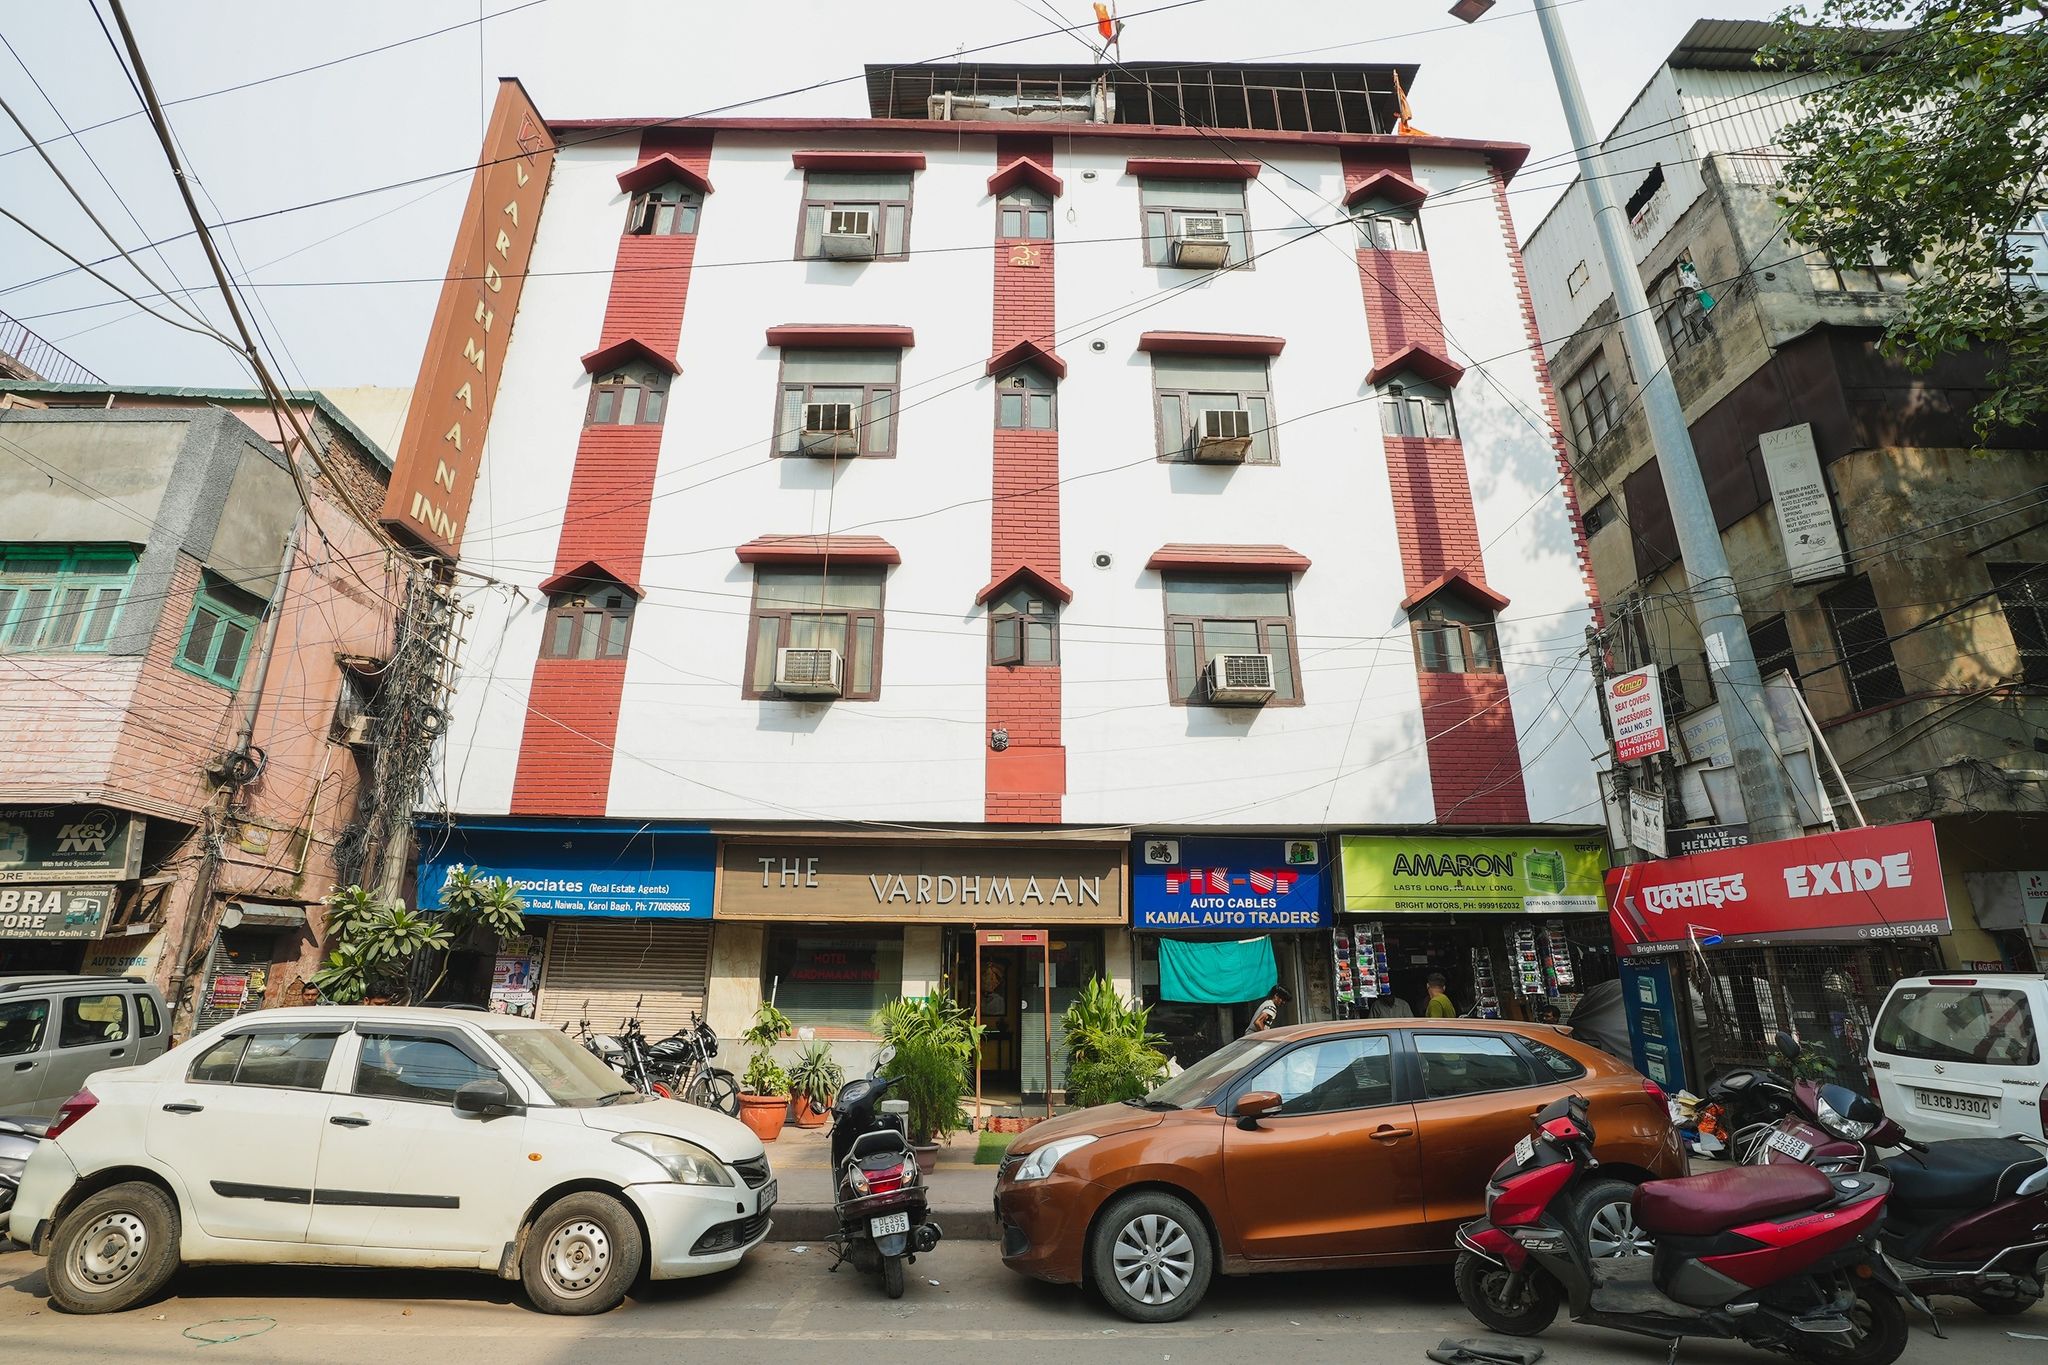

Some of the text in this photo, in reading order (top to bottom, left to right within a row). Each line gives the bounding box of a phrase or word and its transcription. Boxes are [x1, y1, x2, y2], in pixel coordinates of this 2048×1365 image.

[434, 162, 530, 494] VARDHMAAN
[1779, 484, 1818, 496] RUBBER PARTS
[1793, 496, 1813, 505] ELECTRIC
[1783, 504, 1801, 513] ENGINE
[1784, 510, 1803, 519] SPRING
[409, 491, 458, 546] INN
[1614, 693, 1651, 713] SEAT COVERS
[1617, 707, 1653, 727] ACCESSORIES
[1619, 719, 1653, 736] GALI NO. 57
[20, 810, 55, 819] FILTERS
[1696, 830, 1729, 840] MALL OF
[1681, 835, 1748, 850] HELMETS
[42, 860, 55, 868] With
[73, 860, 110, 868] Specifications
[1393, 853, 1514, 877] AMARON
[758, 857, 819, 888] THE
[1783, 852, 1912, 898] EXIDE
[505, 876, 583, 892] Associates
[589, 883, 610, 894] (Real
[611, 884, 636, 893] Estate
[638, 884, 670, 895] Agents)
[868, 873, 1101, 907] VARDHMAAN
[1642, 873, 1747, 915] एक्साइड
[533, 899, 553, 910] Road,
[554, 900, 585, 911] Naiwala,
[588, 901, 608, 910] Karol
[610, 901, 633, 912] Bagh,
[635, 902, 647, 911] Ph:
[1190, 898, 1277, 909] AUTO CABLES
[1395, 901, 1424, 909] BRIGHT
[1426, 902, 1462, 910] MOTORS,
[1145, 911, 1320, 924] KAMAL AUTO TRADERS
[6, 929, 33, 938] Bagh,
[1870, 922, 1938, 938] 9899550448
[1636, 944, 1680, 954] Bright Motors
[92, 956, 149, 967] AUTO STORE
[814, 952, 848, 965] HOTEL
[880, 1223, 906, 1235] F6979
